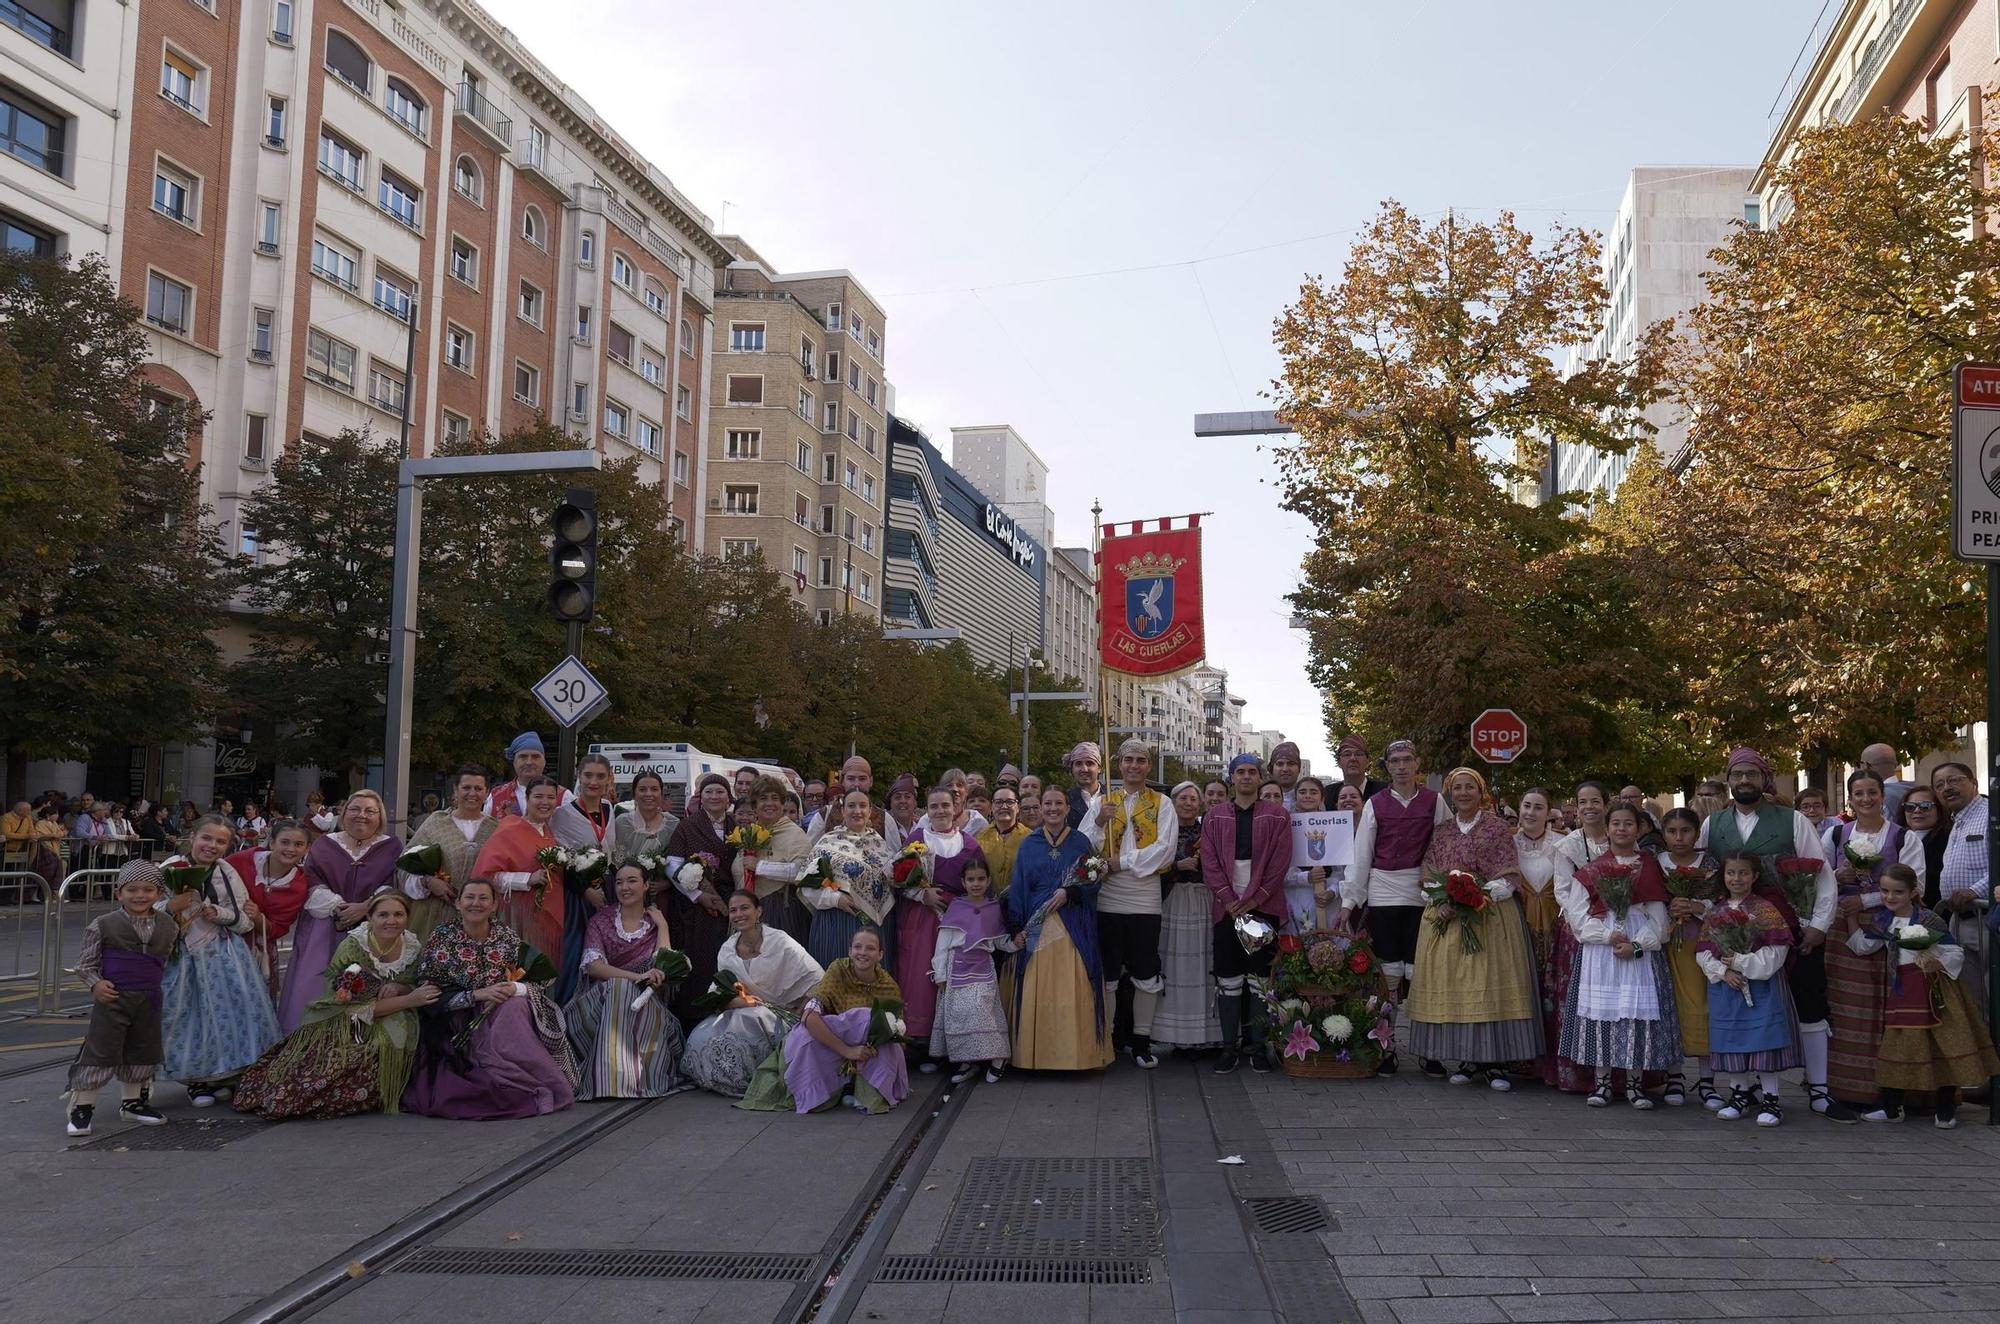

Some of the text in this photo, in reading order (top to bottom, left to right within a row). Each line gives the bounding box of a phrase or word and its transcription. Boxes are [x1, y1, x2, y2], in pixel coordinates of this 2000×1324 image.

[1972, 510, 2000, 524] PRI
[1118, 631, 1186, 657] LAS CUERLAS
[553, 679, 586, 703] 30
[1477, 730, 1521, 742] STOP
[1291, 816, 1348, 827] as Cuerlas
